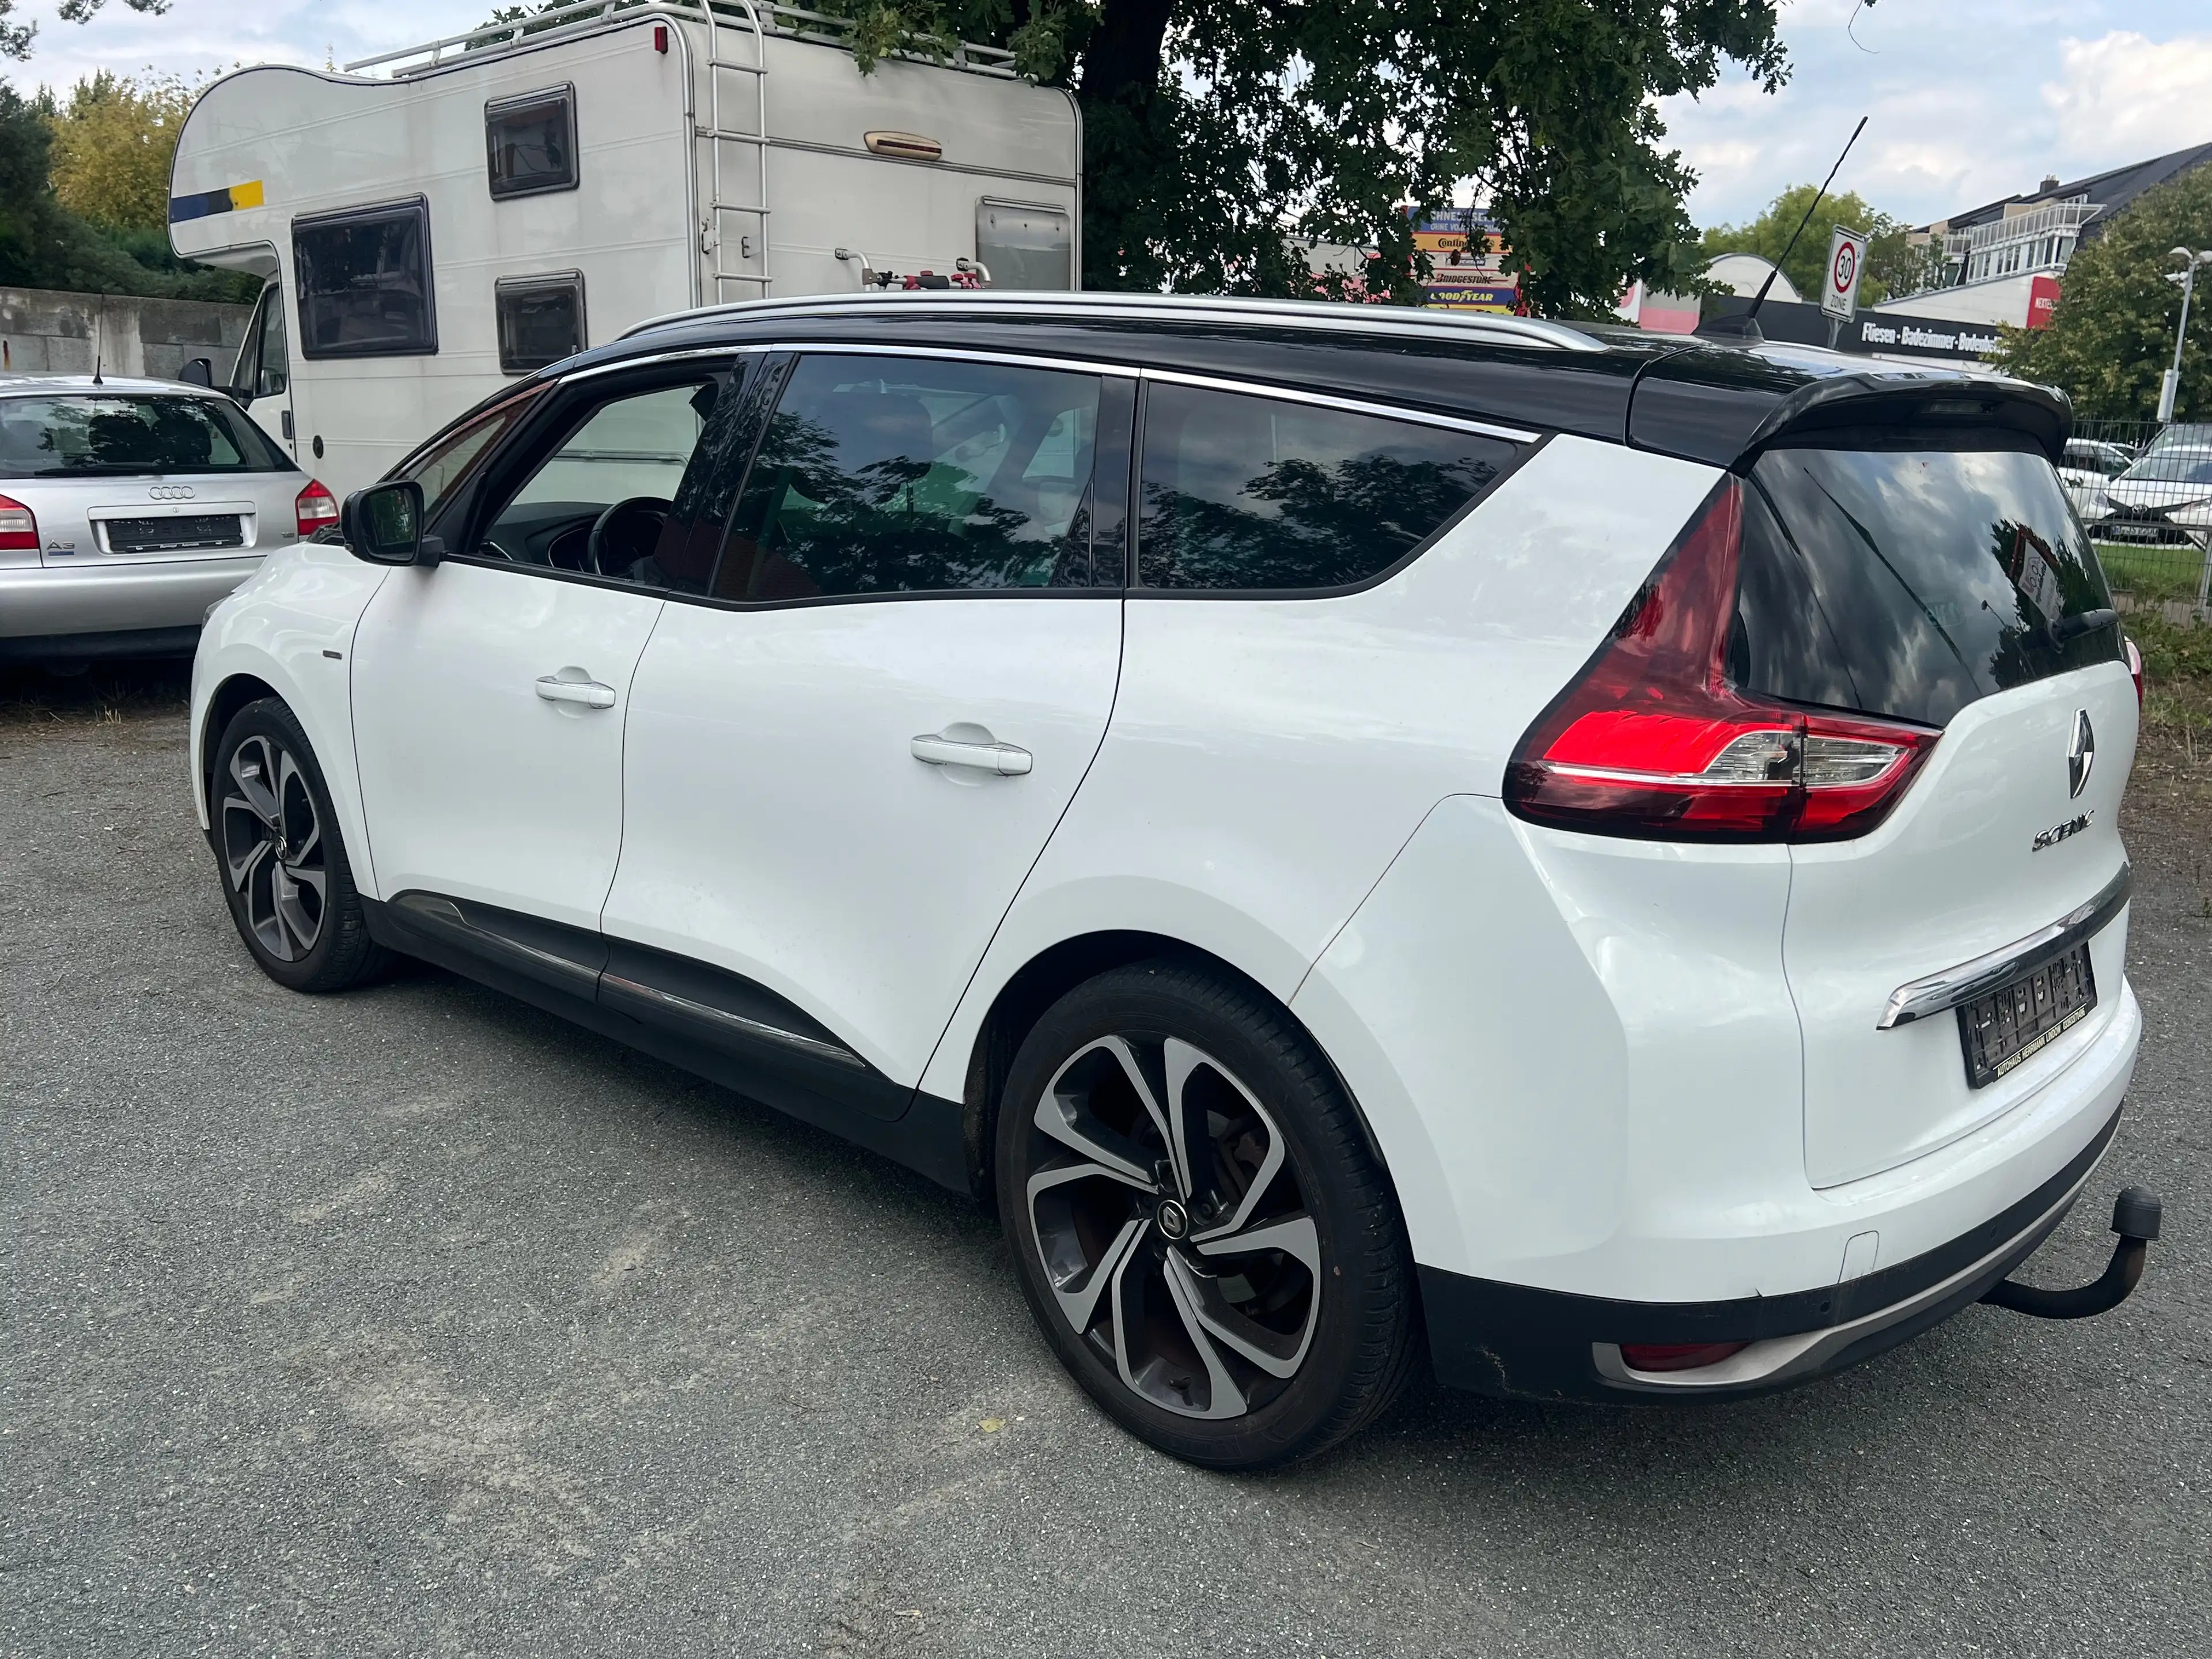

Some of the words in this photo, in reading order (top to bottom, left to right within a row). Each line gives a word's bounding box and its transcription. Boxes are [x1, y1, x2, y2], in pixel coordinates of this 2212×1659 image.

[1430, 223, 1449, 231] OHNE
[1838, 255, 1851, 279] 30
[1435, 273, 1493, 285] BRIDGESTONE
[1830, 294, 1847, 311] ZONE
[1861, 321, 1896, 344] Fliesen
[1901, 325, 1956, 350] Badezimmer
[47, 539, 75, 550] A3
[2032, 809, 2094, 853] SCENIC
[1997, 1053, 2021, 1077] AUTOHAUS
